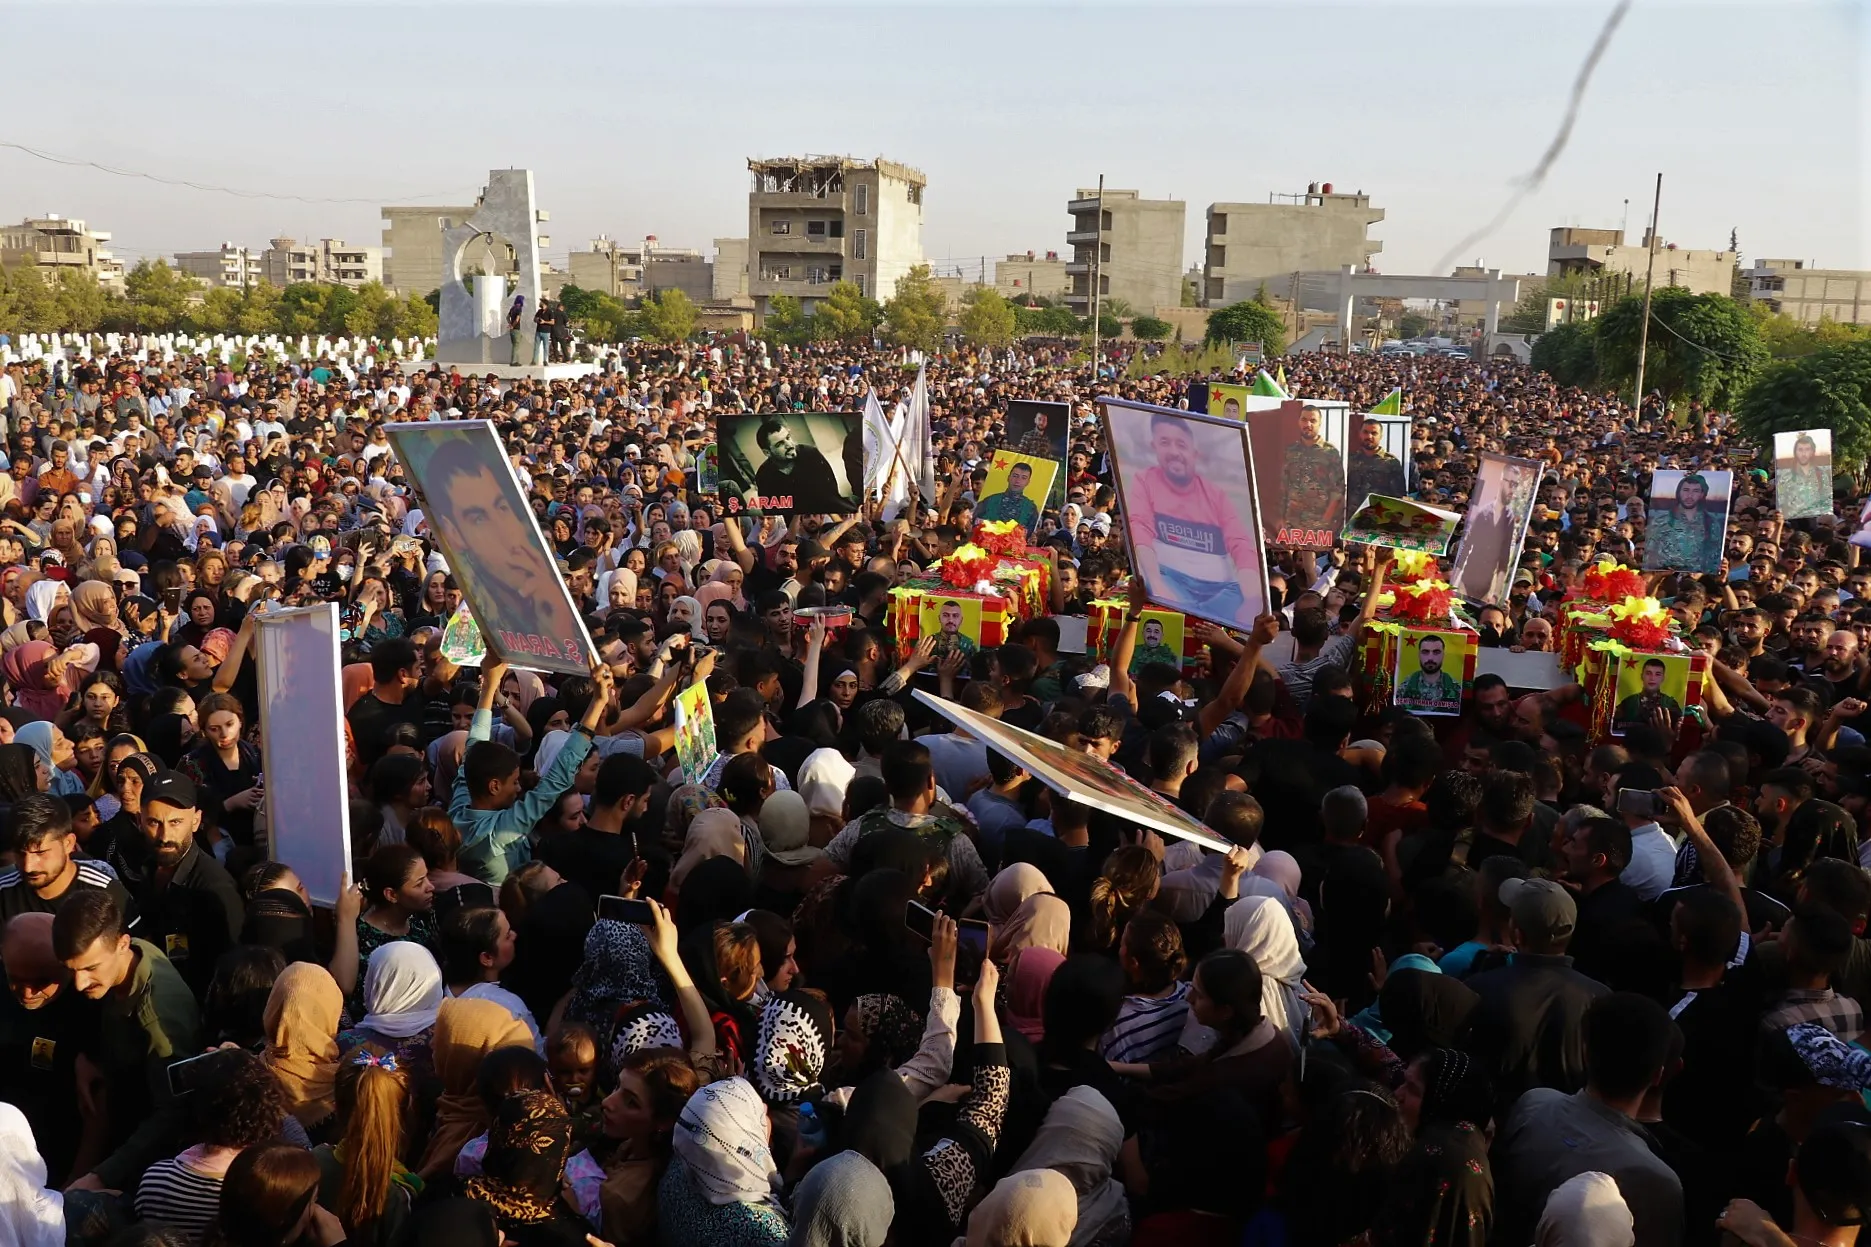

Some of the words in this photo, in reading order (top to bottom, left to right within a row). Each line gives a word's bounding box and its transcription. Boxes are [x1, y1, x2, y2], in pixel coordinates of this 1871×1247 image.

[728, 496, 743, 513] Ş.
[746, 495, 794, 510] ARAM
[1275, 528, 1333, 547] ARAM
